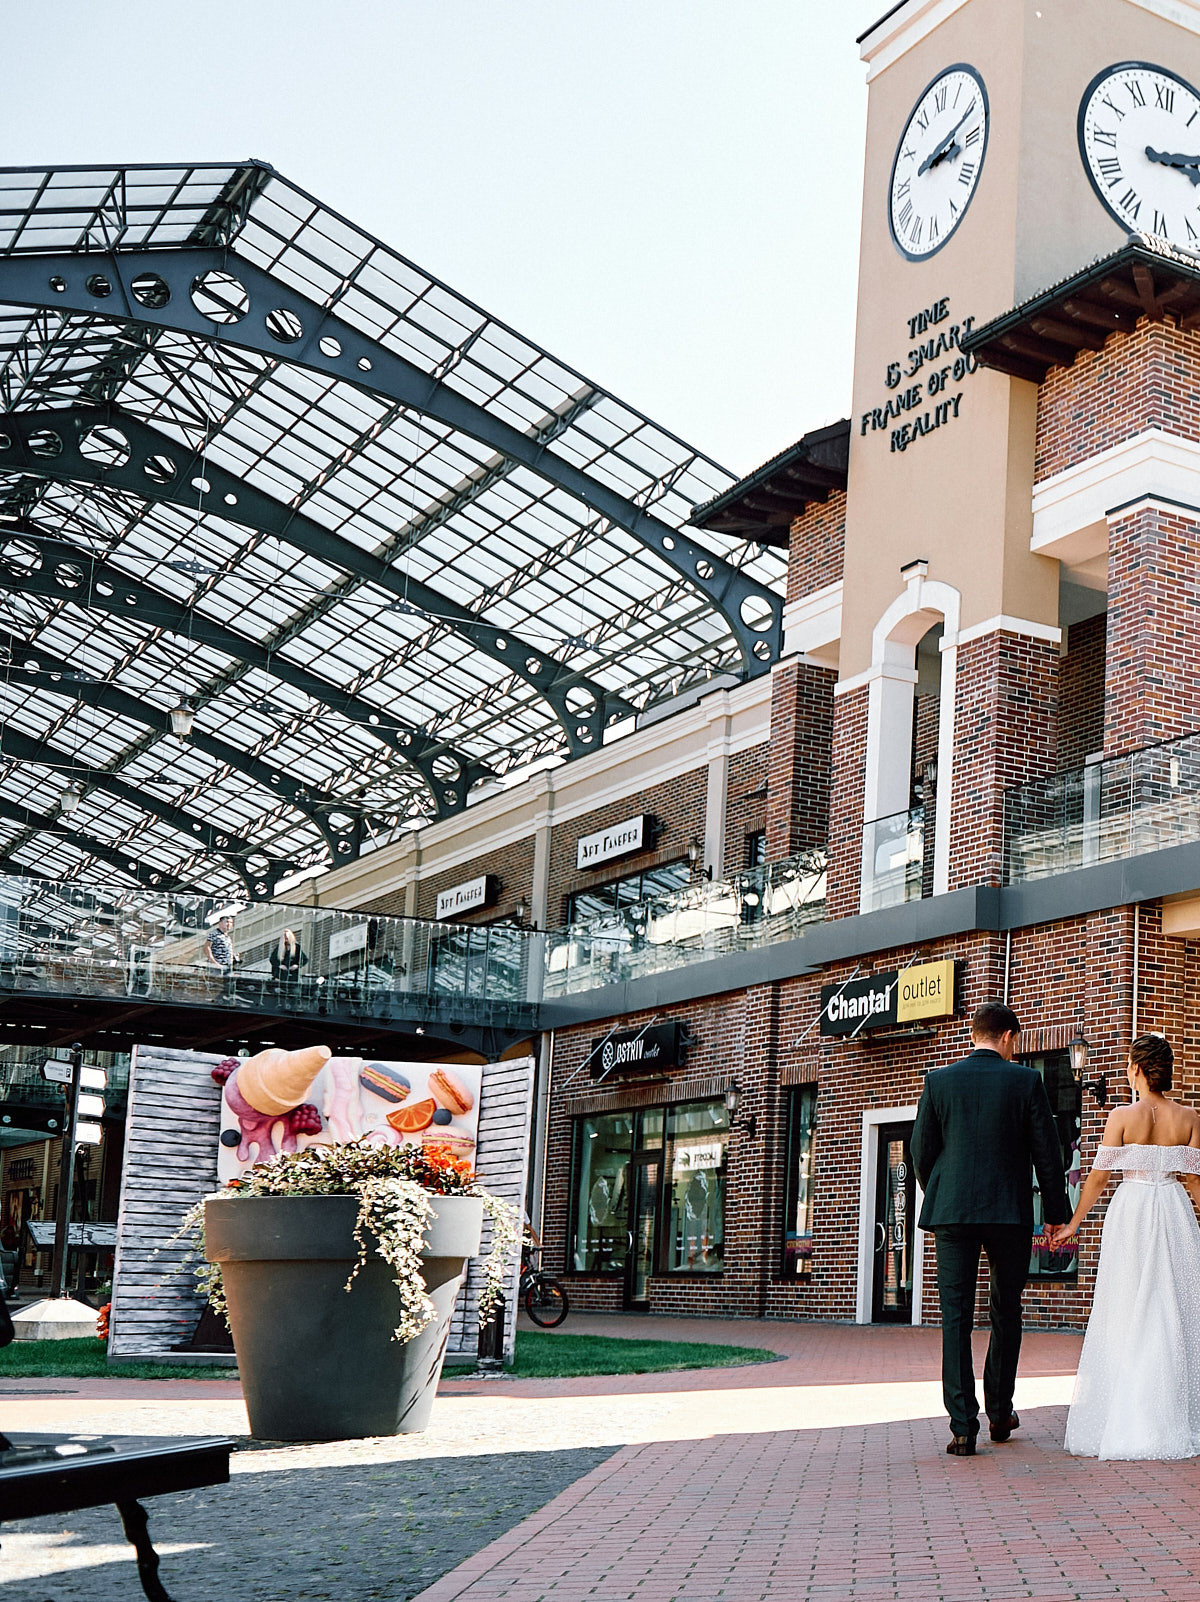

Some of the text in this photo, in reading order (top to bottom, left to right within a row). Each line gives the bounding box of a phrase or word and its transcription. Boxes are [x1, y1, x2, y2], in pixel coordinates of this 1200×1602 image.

[1102, 93, 1126, 122] X
[1124, 80, 1146, 108] XI
[1155, 82, 1174, 115] XII
[907, 297, 950, 339] TIME
[885, 316, 976, 389] IS SMART
[860, 352, 979, 436] FRAME OF OU
[890, 392, 963, 452] REALITY
[827, 984, 891, 1022] Chantal
[902, 975, 942, 1001] outlet
[617, 1039, 644, 1063] OSTRIV
